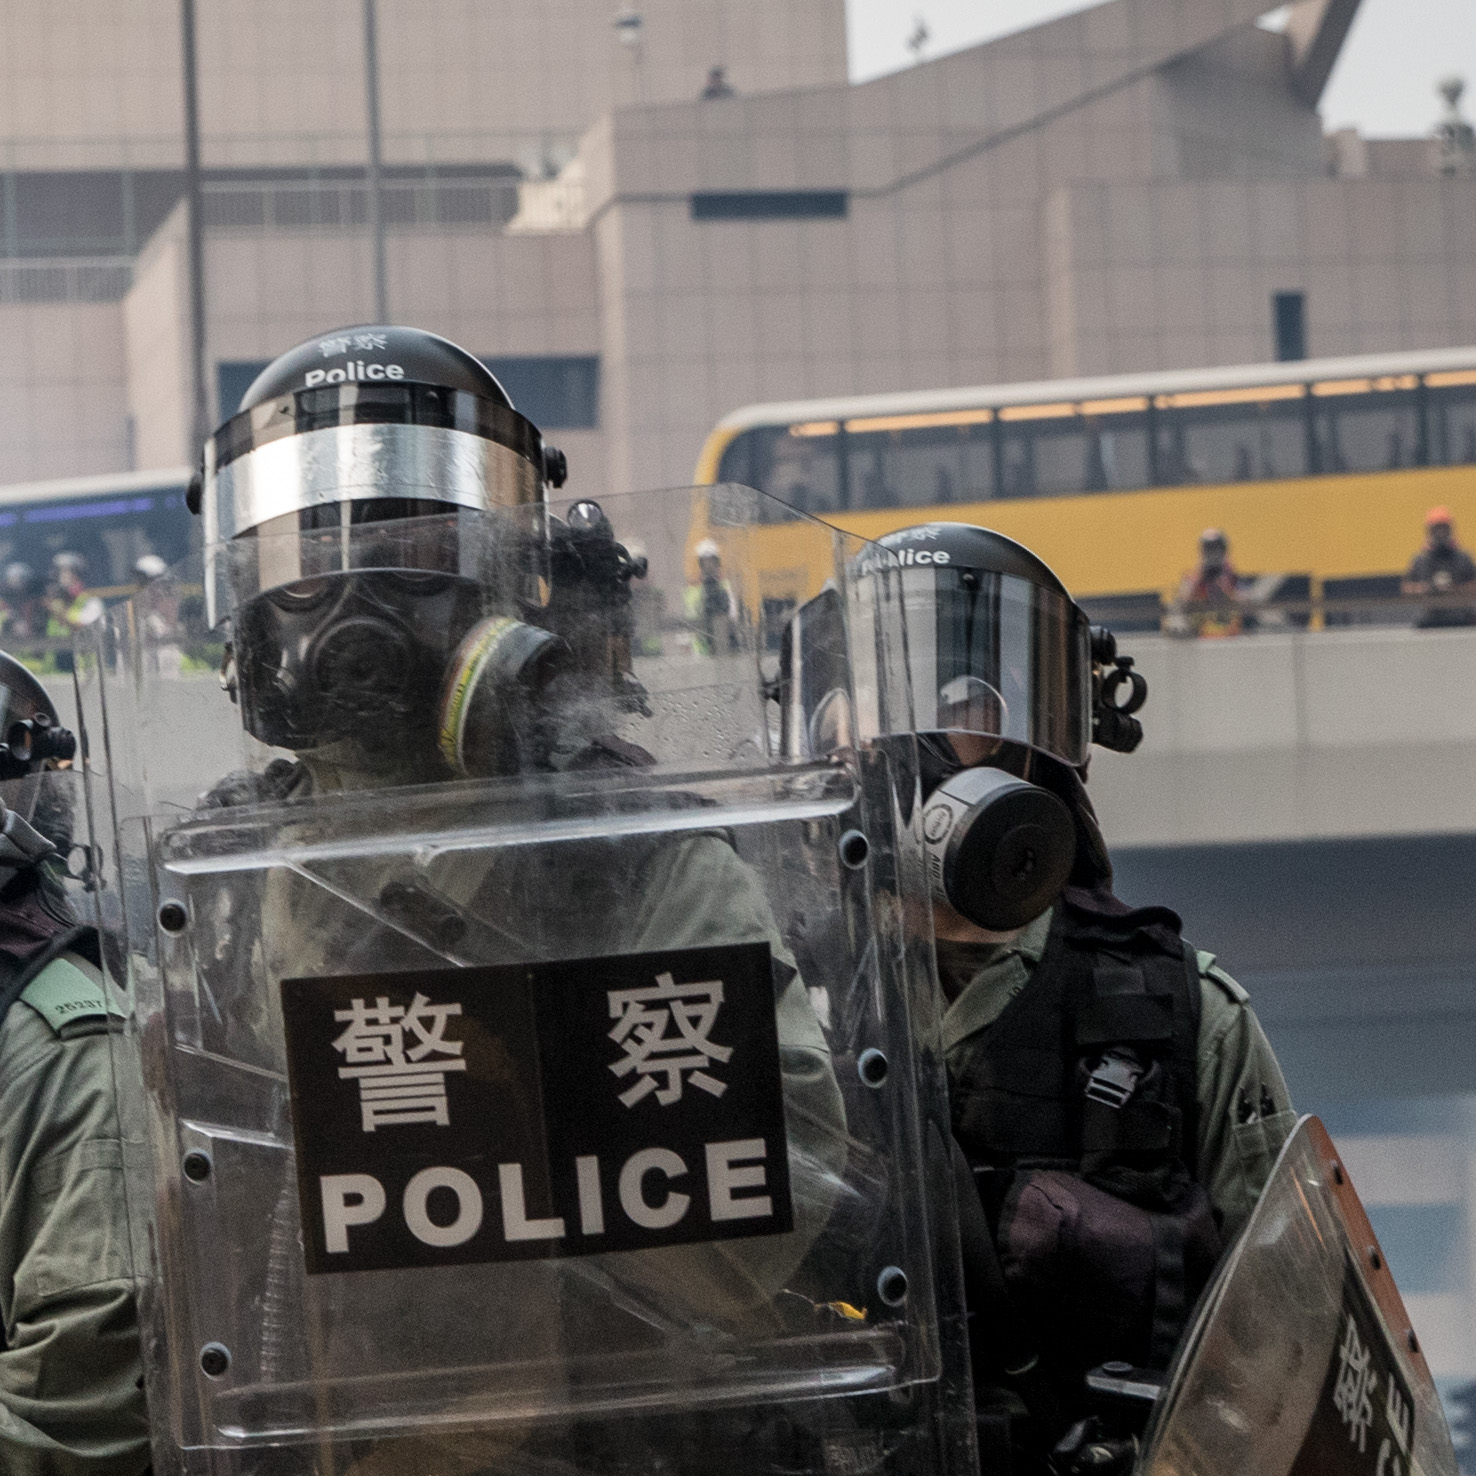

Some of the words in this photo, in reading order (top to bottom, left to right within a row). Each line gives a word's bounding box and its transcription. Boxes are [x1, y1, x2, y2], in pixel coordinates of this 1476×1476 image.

[305, 360, 405, 388] Police
[330, 971, 734, 1132] 警察
[319, 1137, 773, 1254] POLICE
